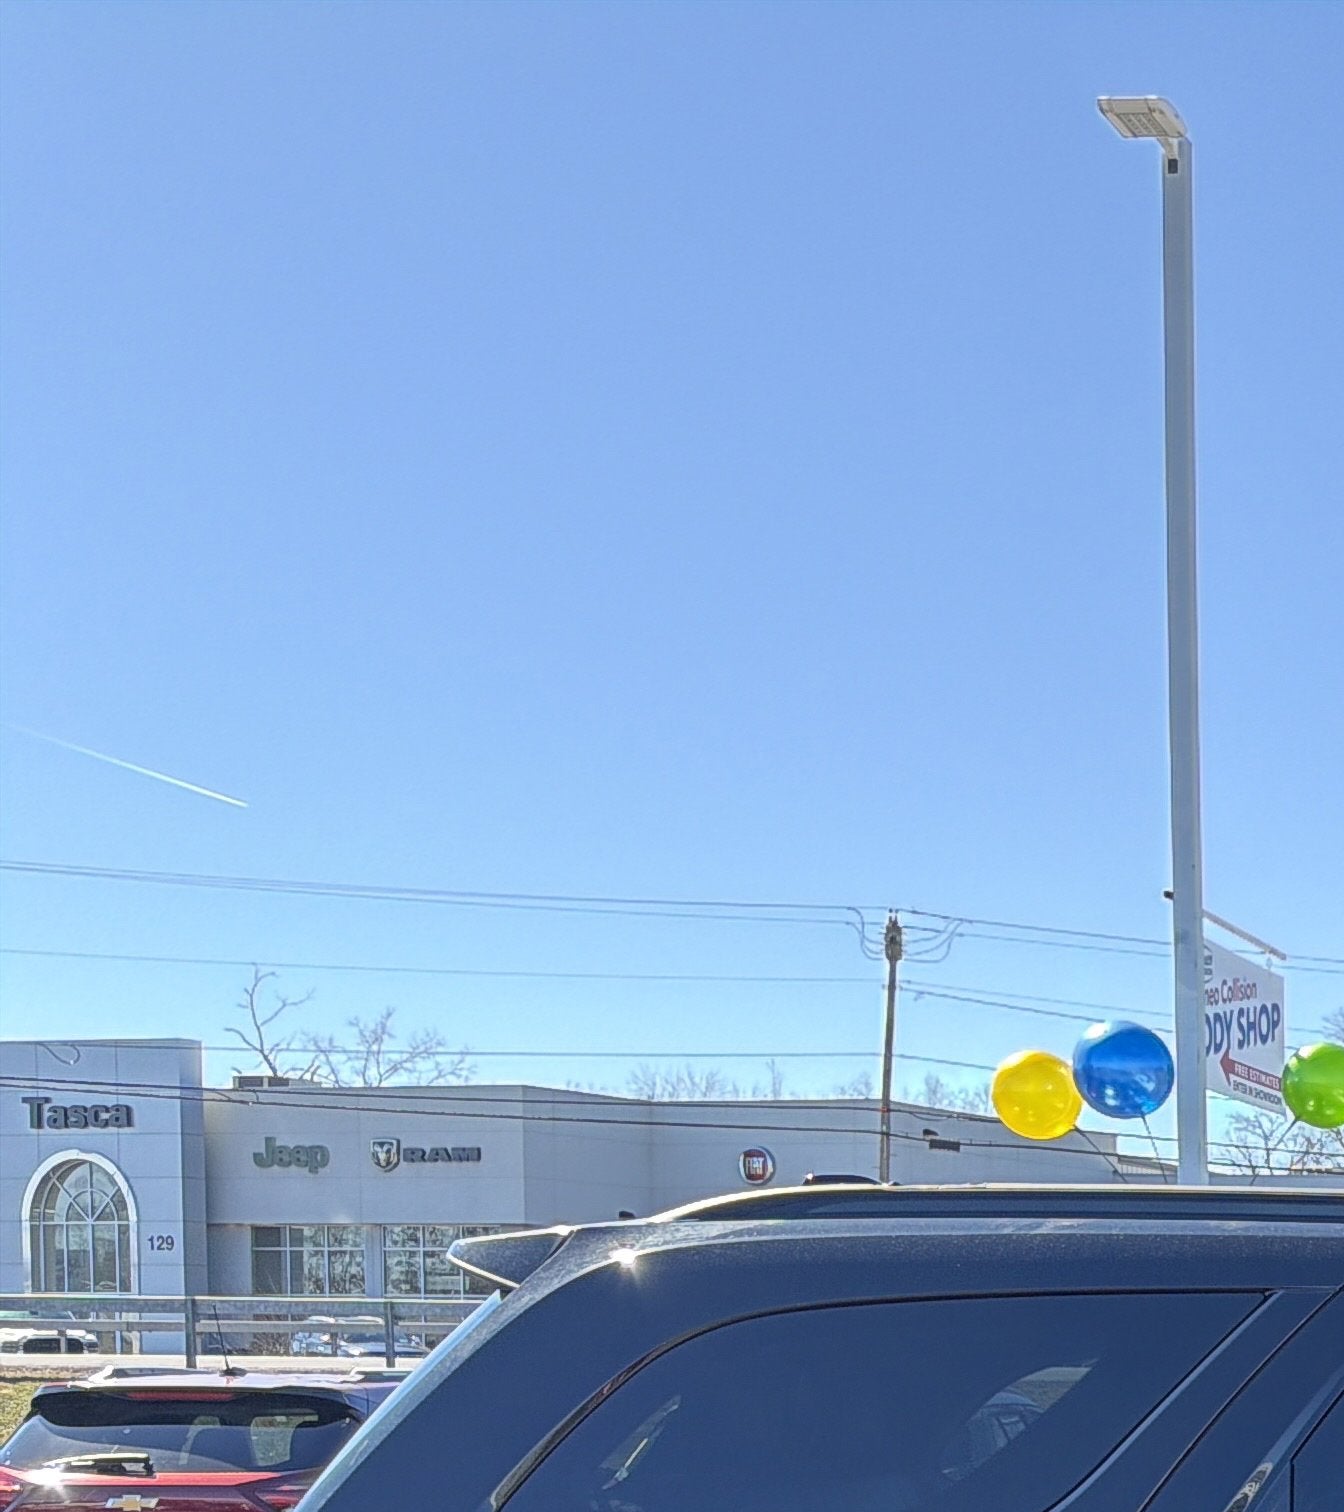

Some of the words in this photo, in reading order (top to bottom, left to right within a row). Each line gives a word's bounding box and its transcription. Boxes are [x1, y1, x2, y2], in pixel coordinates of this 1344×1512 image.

[1221, 975, 1257, 1004] Collision
[1237, 1003, 1281, 1050] SHOP
[1234, 1062, 1248, 1079] FREE
[1249, 1067, 1280, 1090] ESTIMATES
[21, 1096, 134, 1129] Tasca
[253, 1137, 329, 1174] Jeep
[403, 1147, 481, 1163] RAM
[147, 1235, 174, 1251] 129
